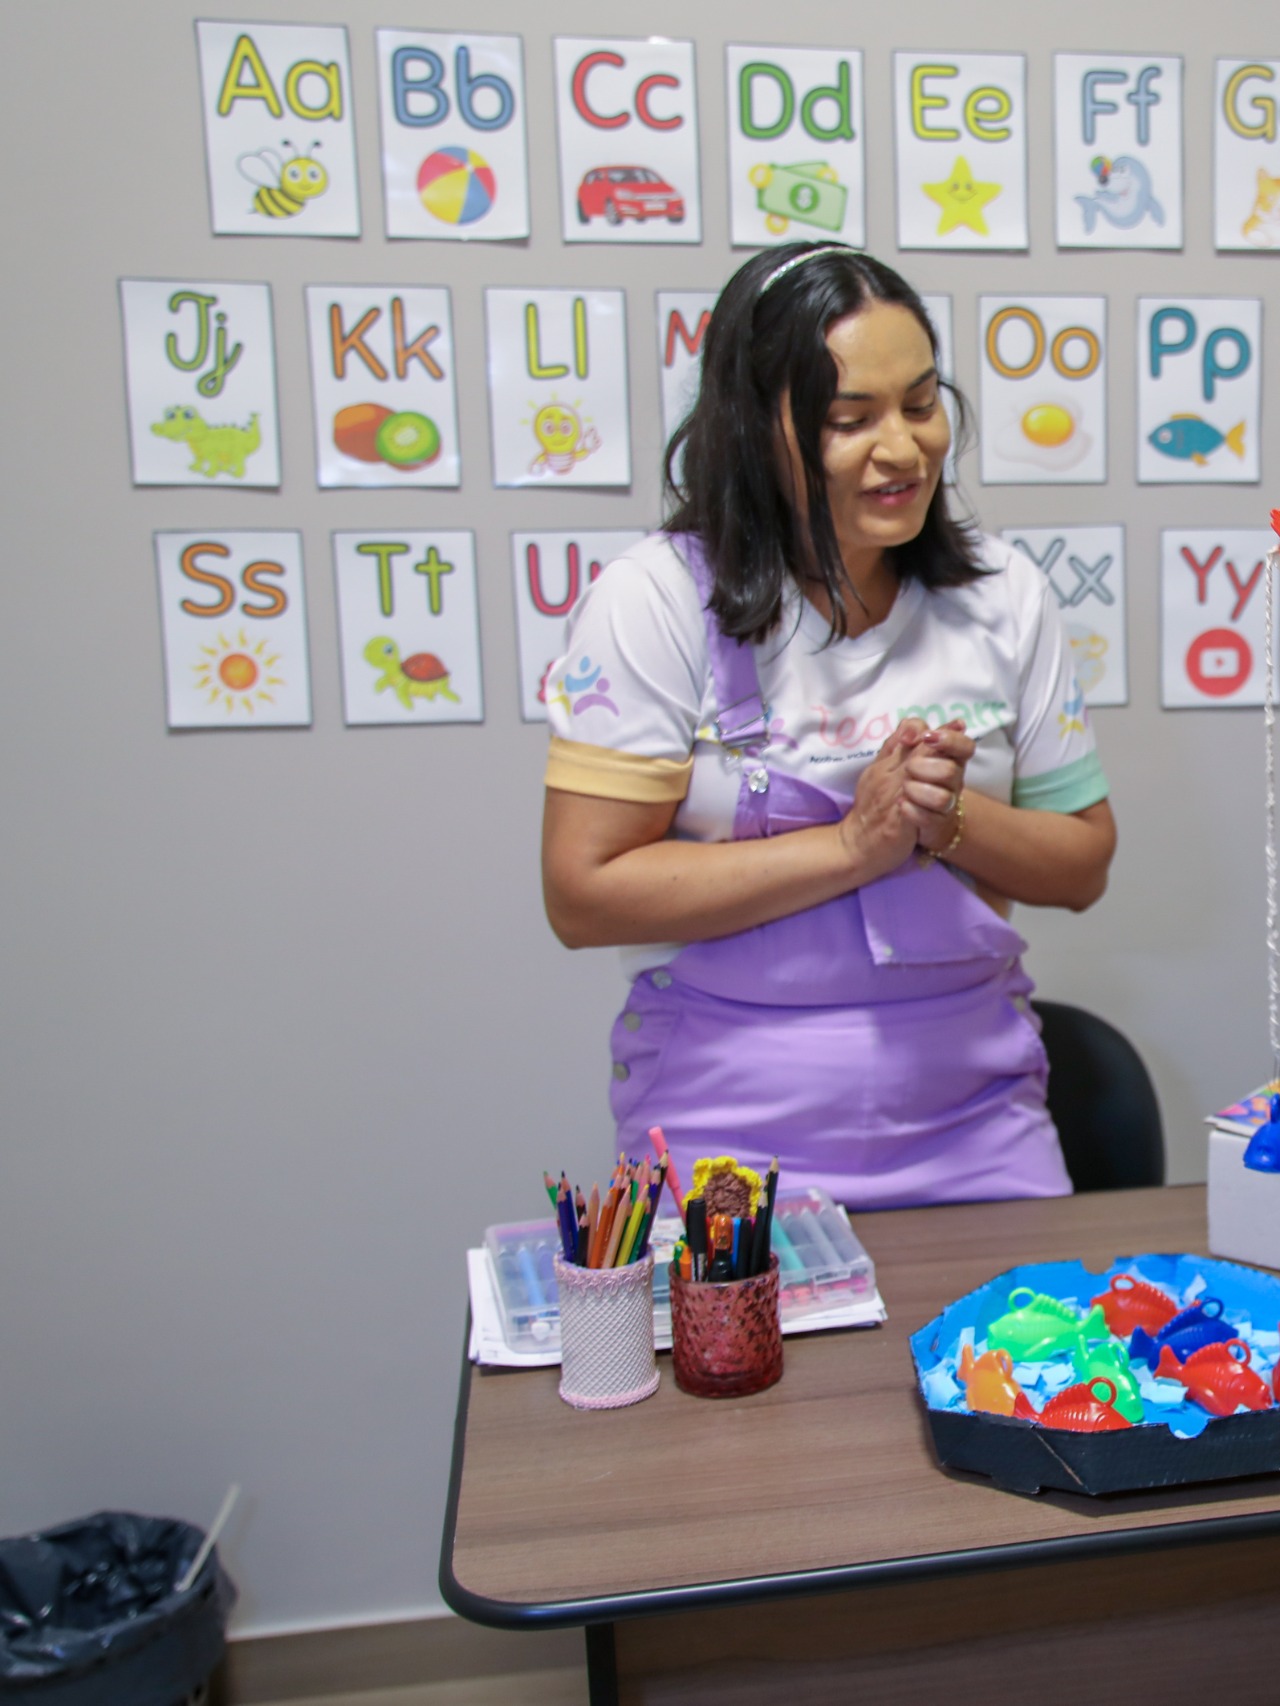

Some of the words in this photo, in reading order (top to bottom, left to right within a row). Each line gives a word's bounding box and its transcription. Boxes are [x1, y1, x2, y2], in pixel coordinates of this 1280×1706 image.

[217, 34, 343, 121] Aa
[391, 46, 516, 131] Bb
[571, 51, 683, 131] Cc
[739, 61, 855, 143] Dd
[910, 64, 1012, 142] Ee
[1082, 66, 1162, 146] Ff
[165, 290, 243, 398] Jj
[329, 297, 444, 381] Kk
[525, 297, 587, 380] Ll
[985, 306, 1101, 380] Oo
[1149, 306, 1251, 402] Pp
[181, 542, 288, 618] Ss
[357, 543, 455, 616] Tt
[527, 543, 600, 616] U
[1013, 538, 1114, 608] Xx
[1180, 546, 1263, 619] Yy
